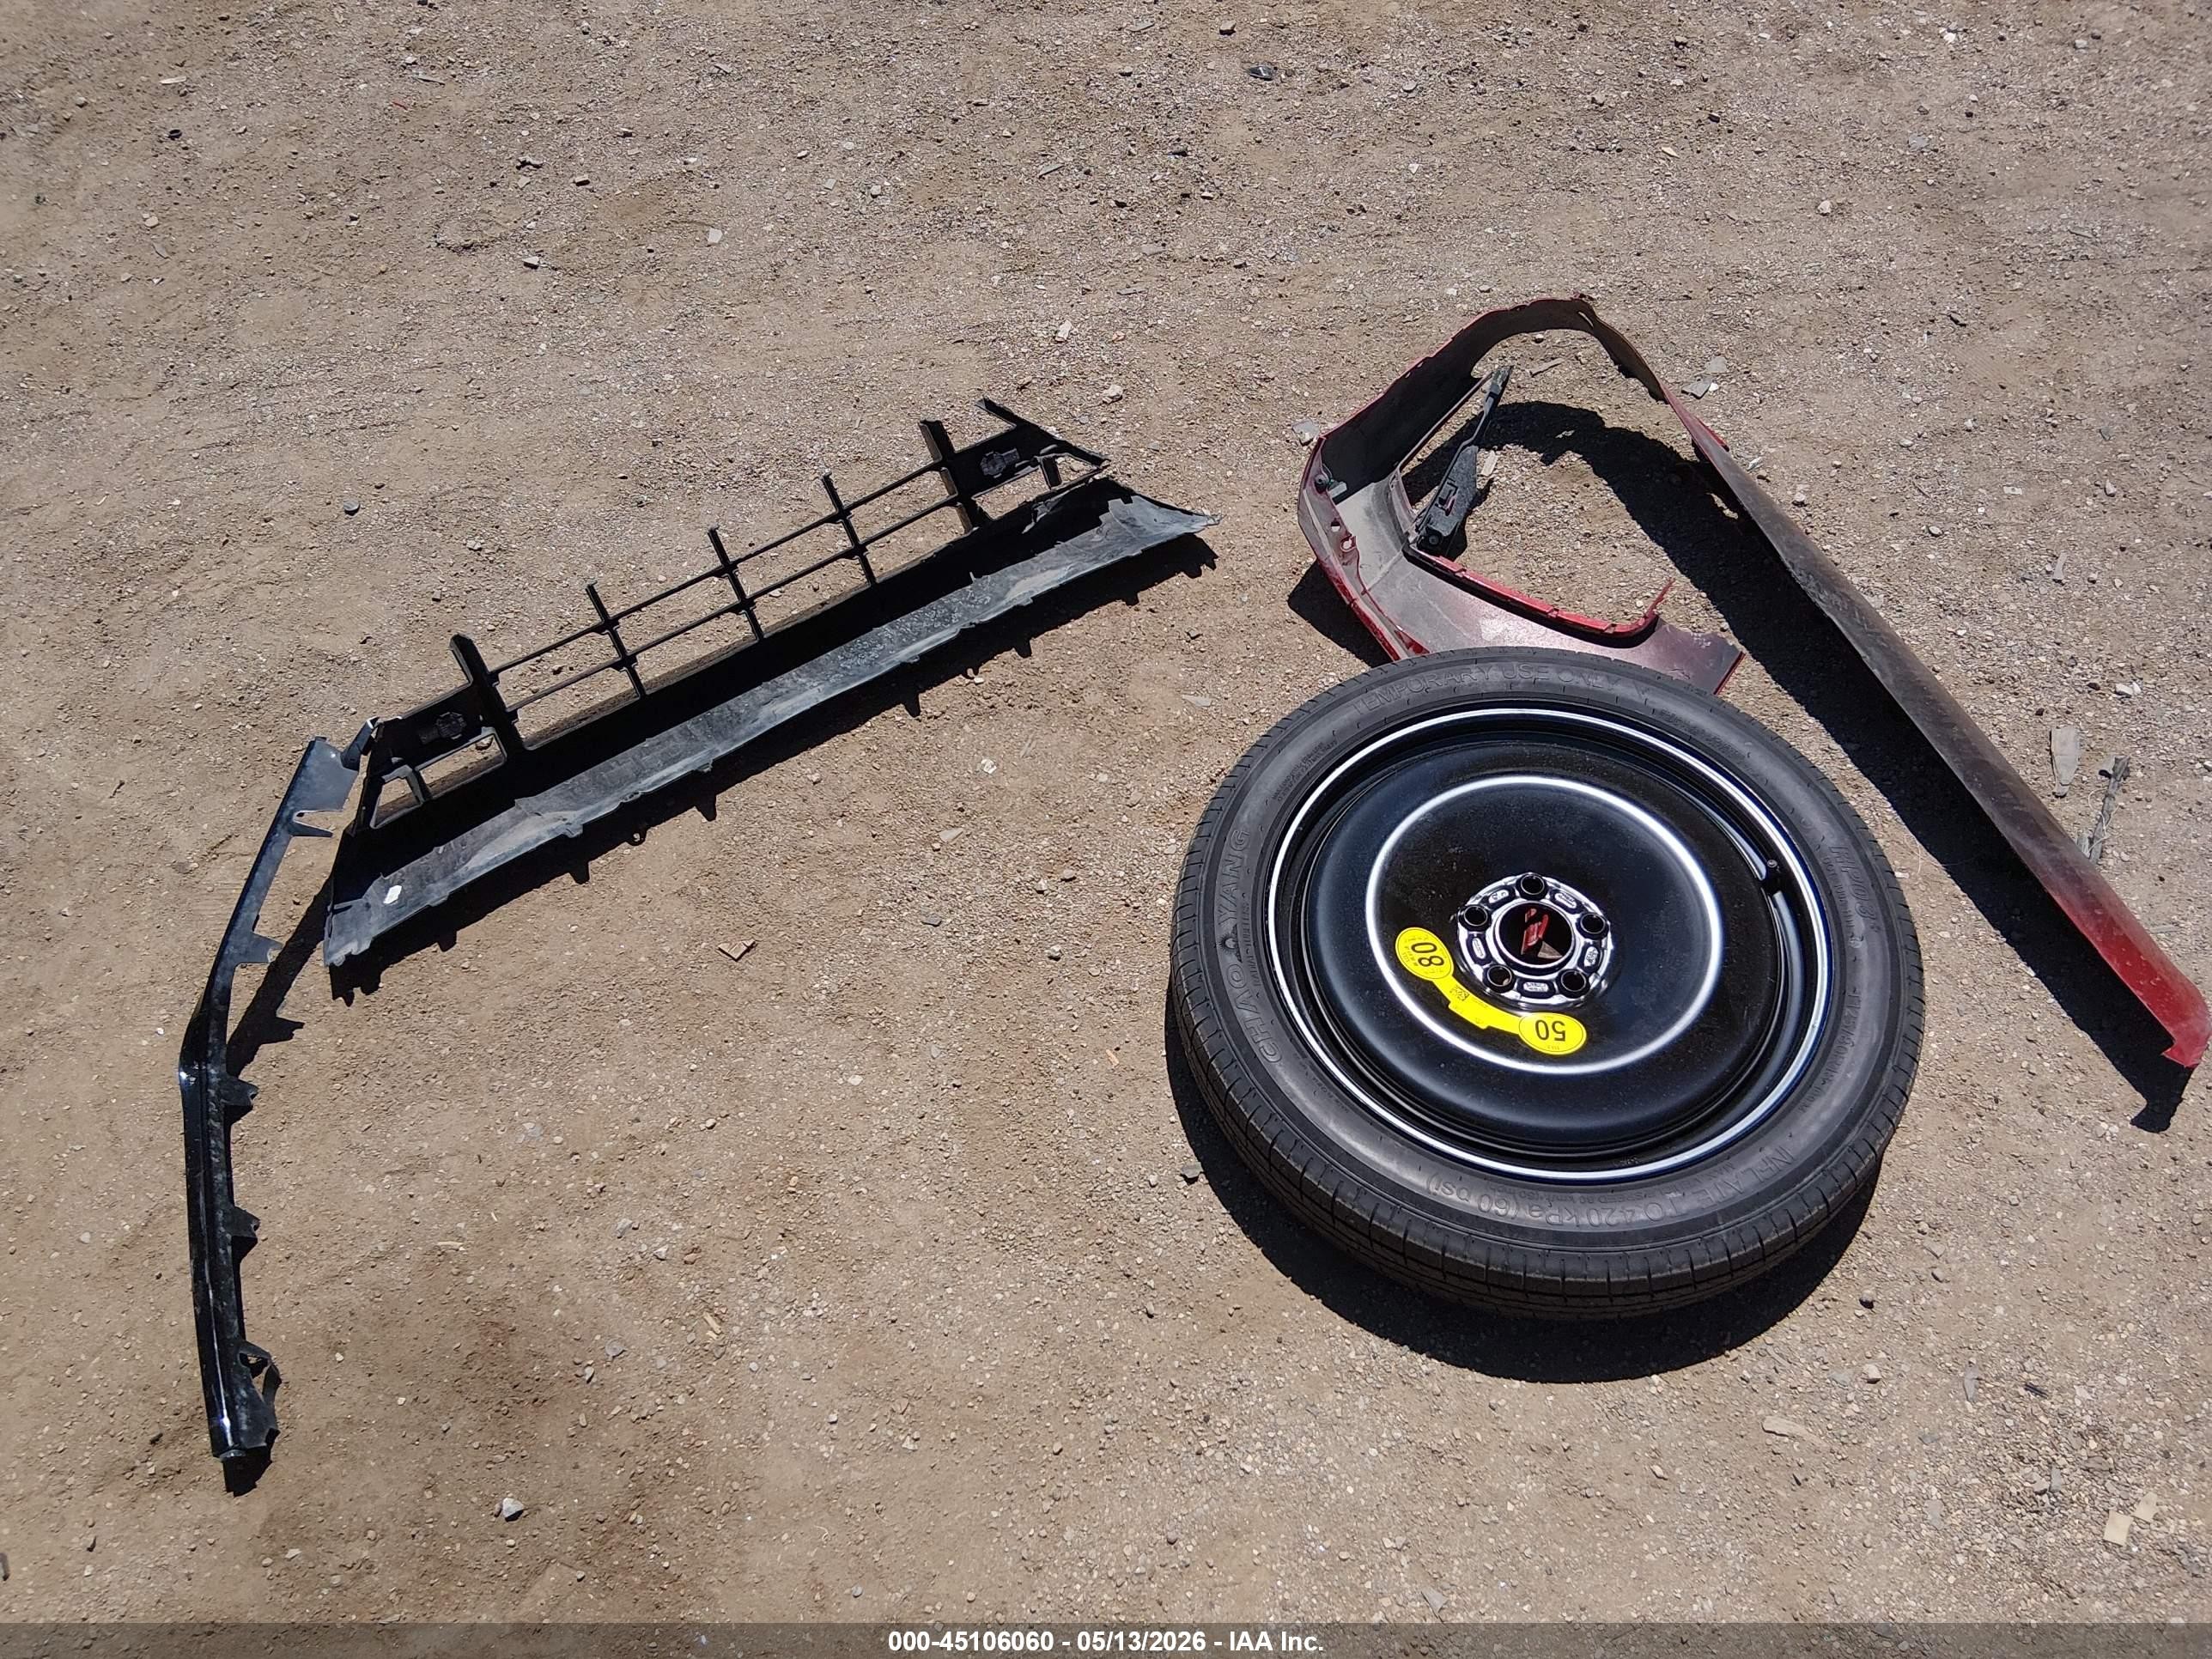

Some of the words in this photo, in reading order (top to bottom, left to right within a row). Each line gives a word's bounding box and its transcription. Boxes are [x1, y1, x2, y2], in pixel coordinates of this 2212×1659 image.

[1352, 665, 1492, 714] TEMPORARY
[1502, 663, 1550, 681] USE
[1557, 667, 1622, 690] ONLY
[1218, 829, 1250, 927] YANG
[1241, 902, 1252, 948] TUBELESS
[1411, 942, 1444, 968] 80
[1245, 954, 1262, 987] RADIAL
[1226, 963, 1282, 1063] CHAO
[1534, 1019, 1566, 1042] 50
[1425, 1173, 1472, 1202] psi)
[1690, 1146, 1795, 1205] INFLATE
[1477, 1193, 1519, 1219] (60
[1597, 1192, 1644, 1203] SPEED
[1644, 1194, 1689, 1222] TO
[1527, 1203, 1581, 1227] kPa
[1587, 1206, 1635, 1228] 420
